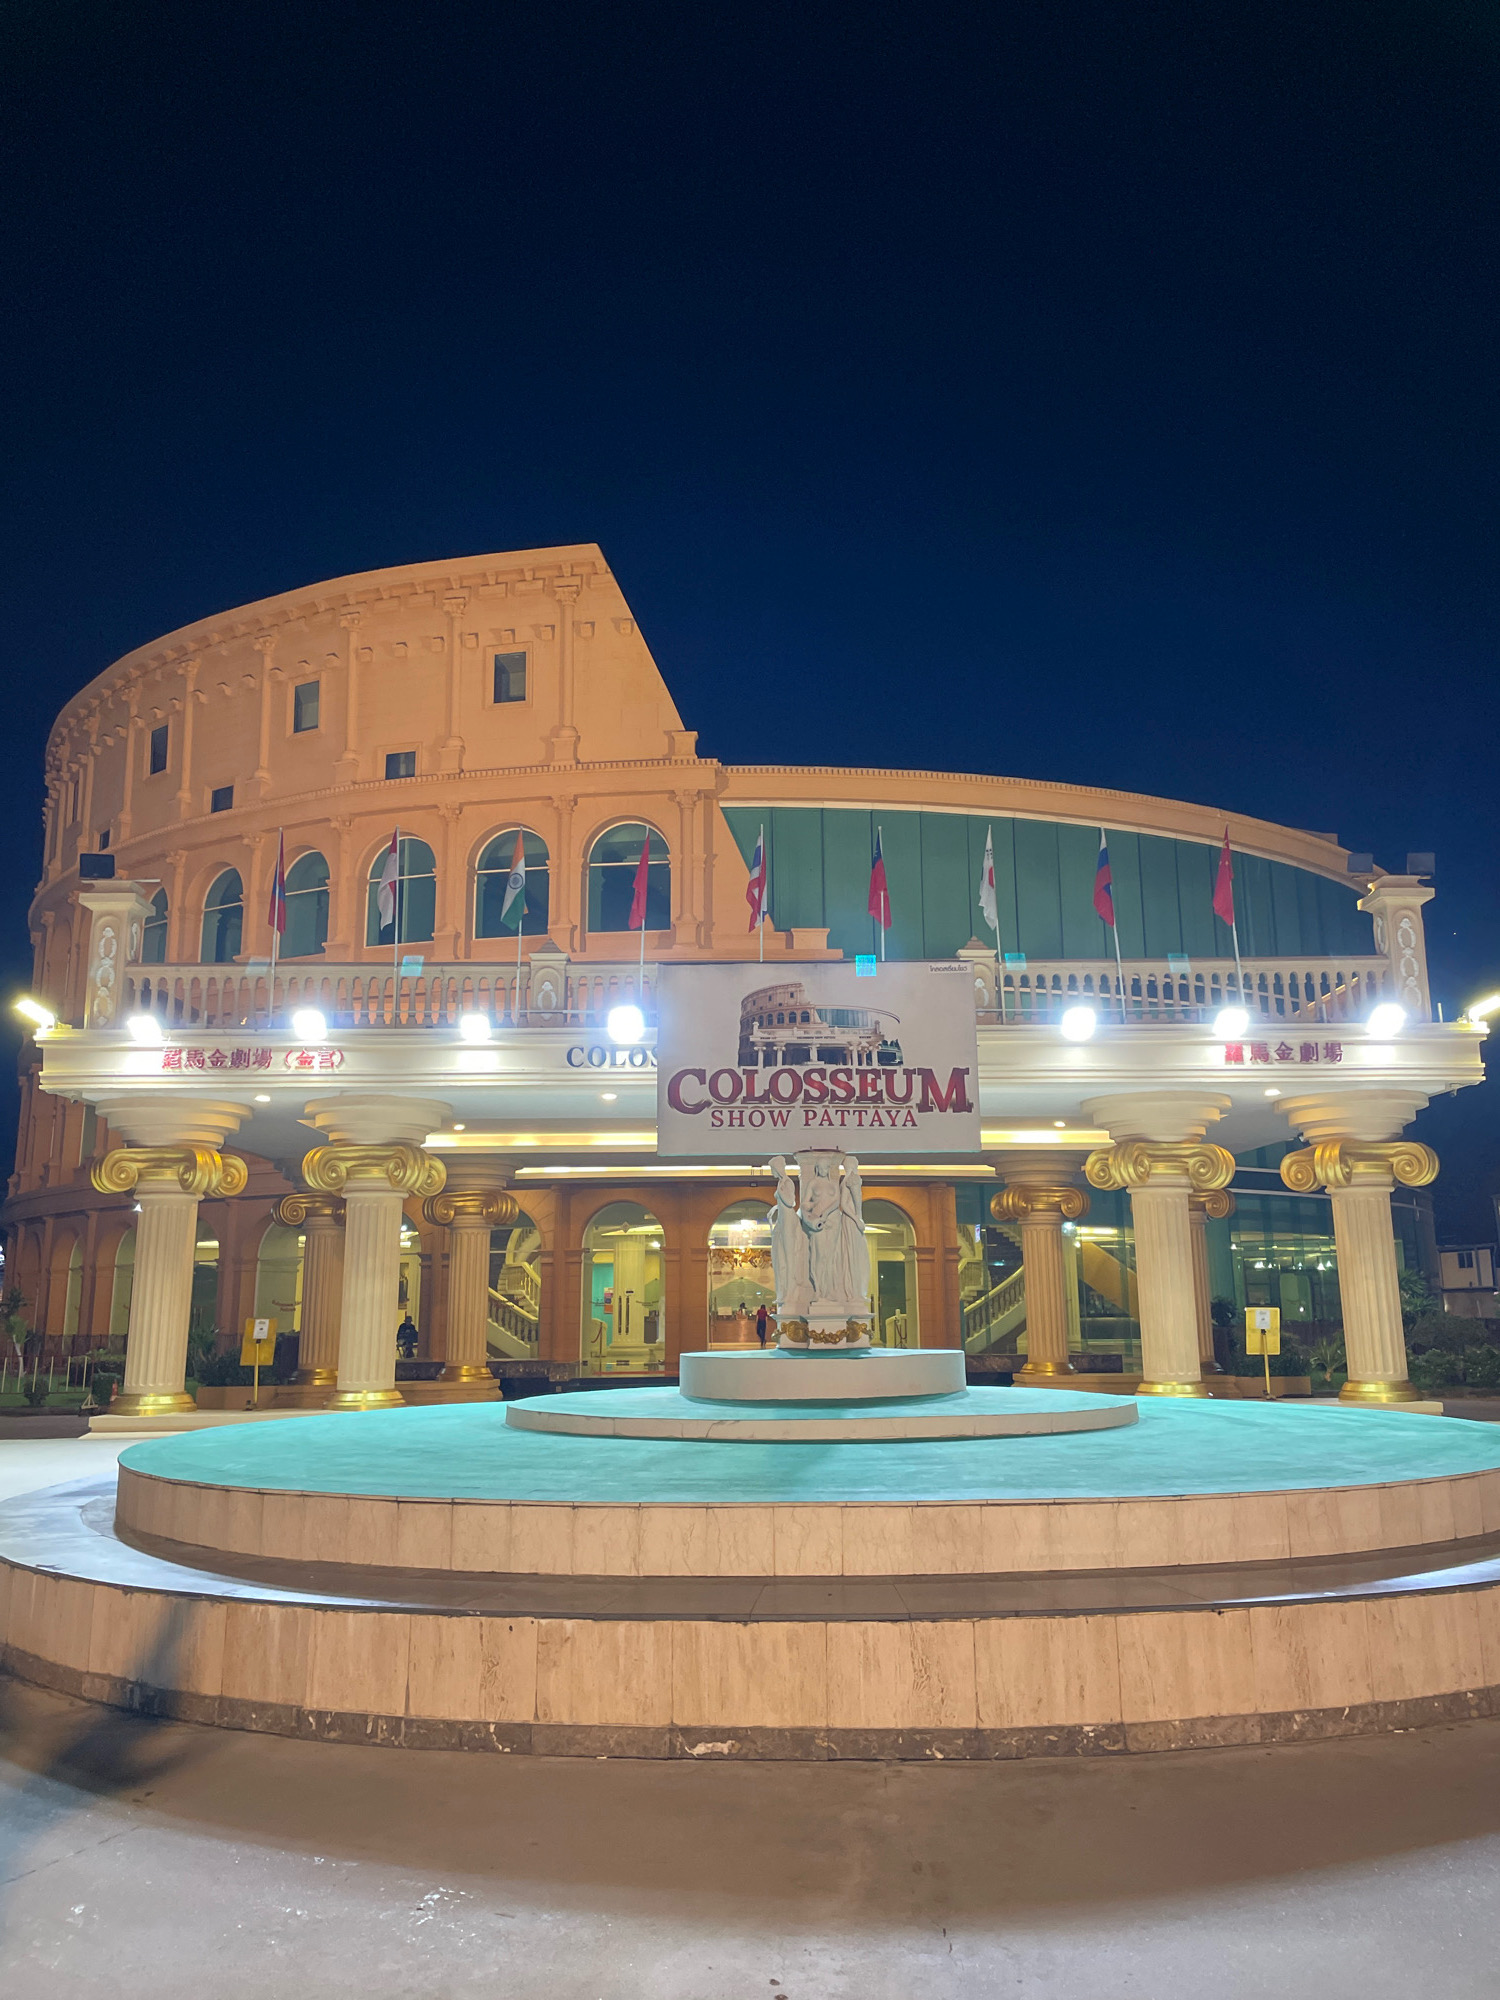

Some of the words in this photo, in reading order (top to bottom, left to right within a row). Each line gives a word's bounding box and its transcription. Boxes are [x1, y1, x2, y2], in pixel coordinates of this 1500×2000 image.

[667, 1067, 974, 1114] COLOSSEUM
[711, 1109, 791, 1128] SHOW
[803, 1109, 918, 1127] PATTAYA
